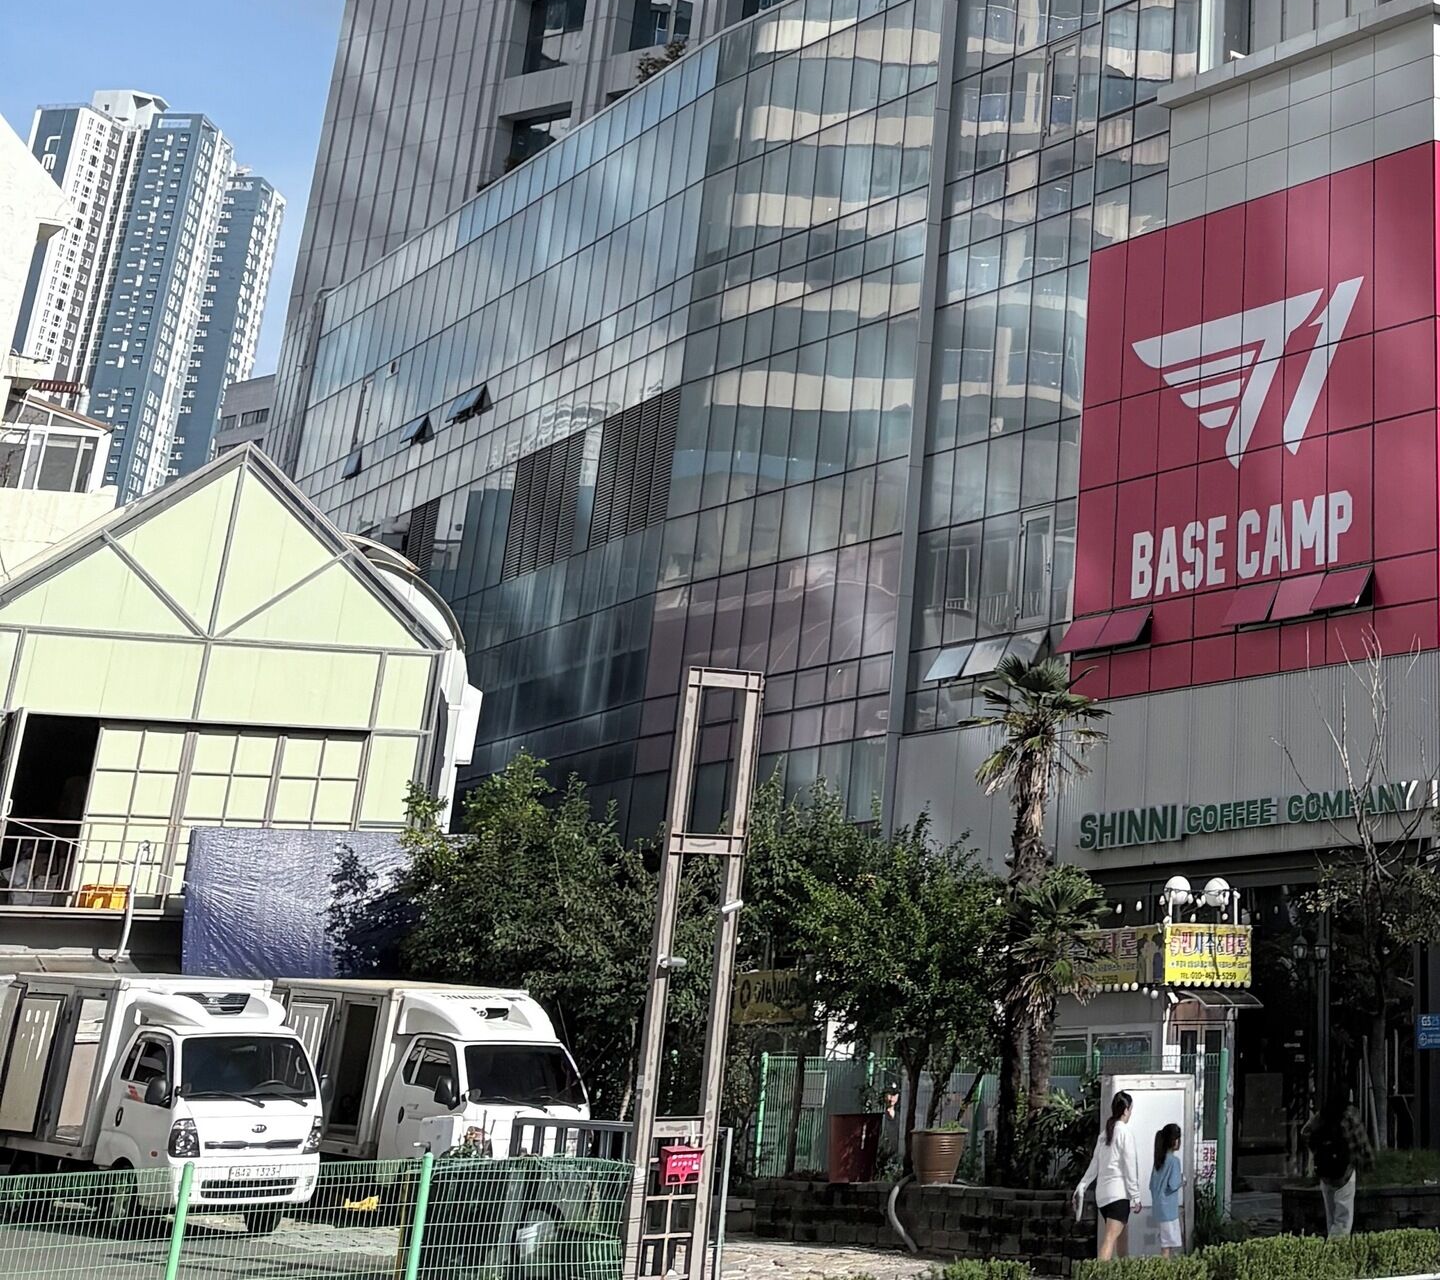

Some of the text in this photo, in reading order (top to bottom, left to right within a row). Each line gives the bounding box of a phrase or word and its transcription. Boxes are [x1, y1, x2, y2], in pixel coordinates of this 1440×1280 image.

[1131, 490, 1353, 600] BASE CAMP
[1078, 780, 1418, 850] SHINNI COFFEE COMPANY
